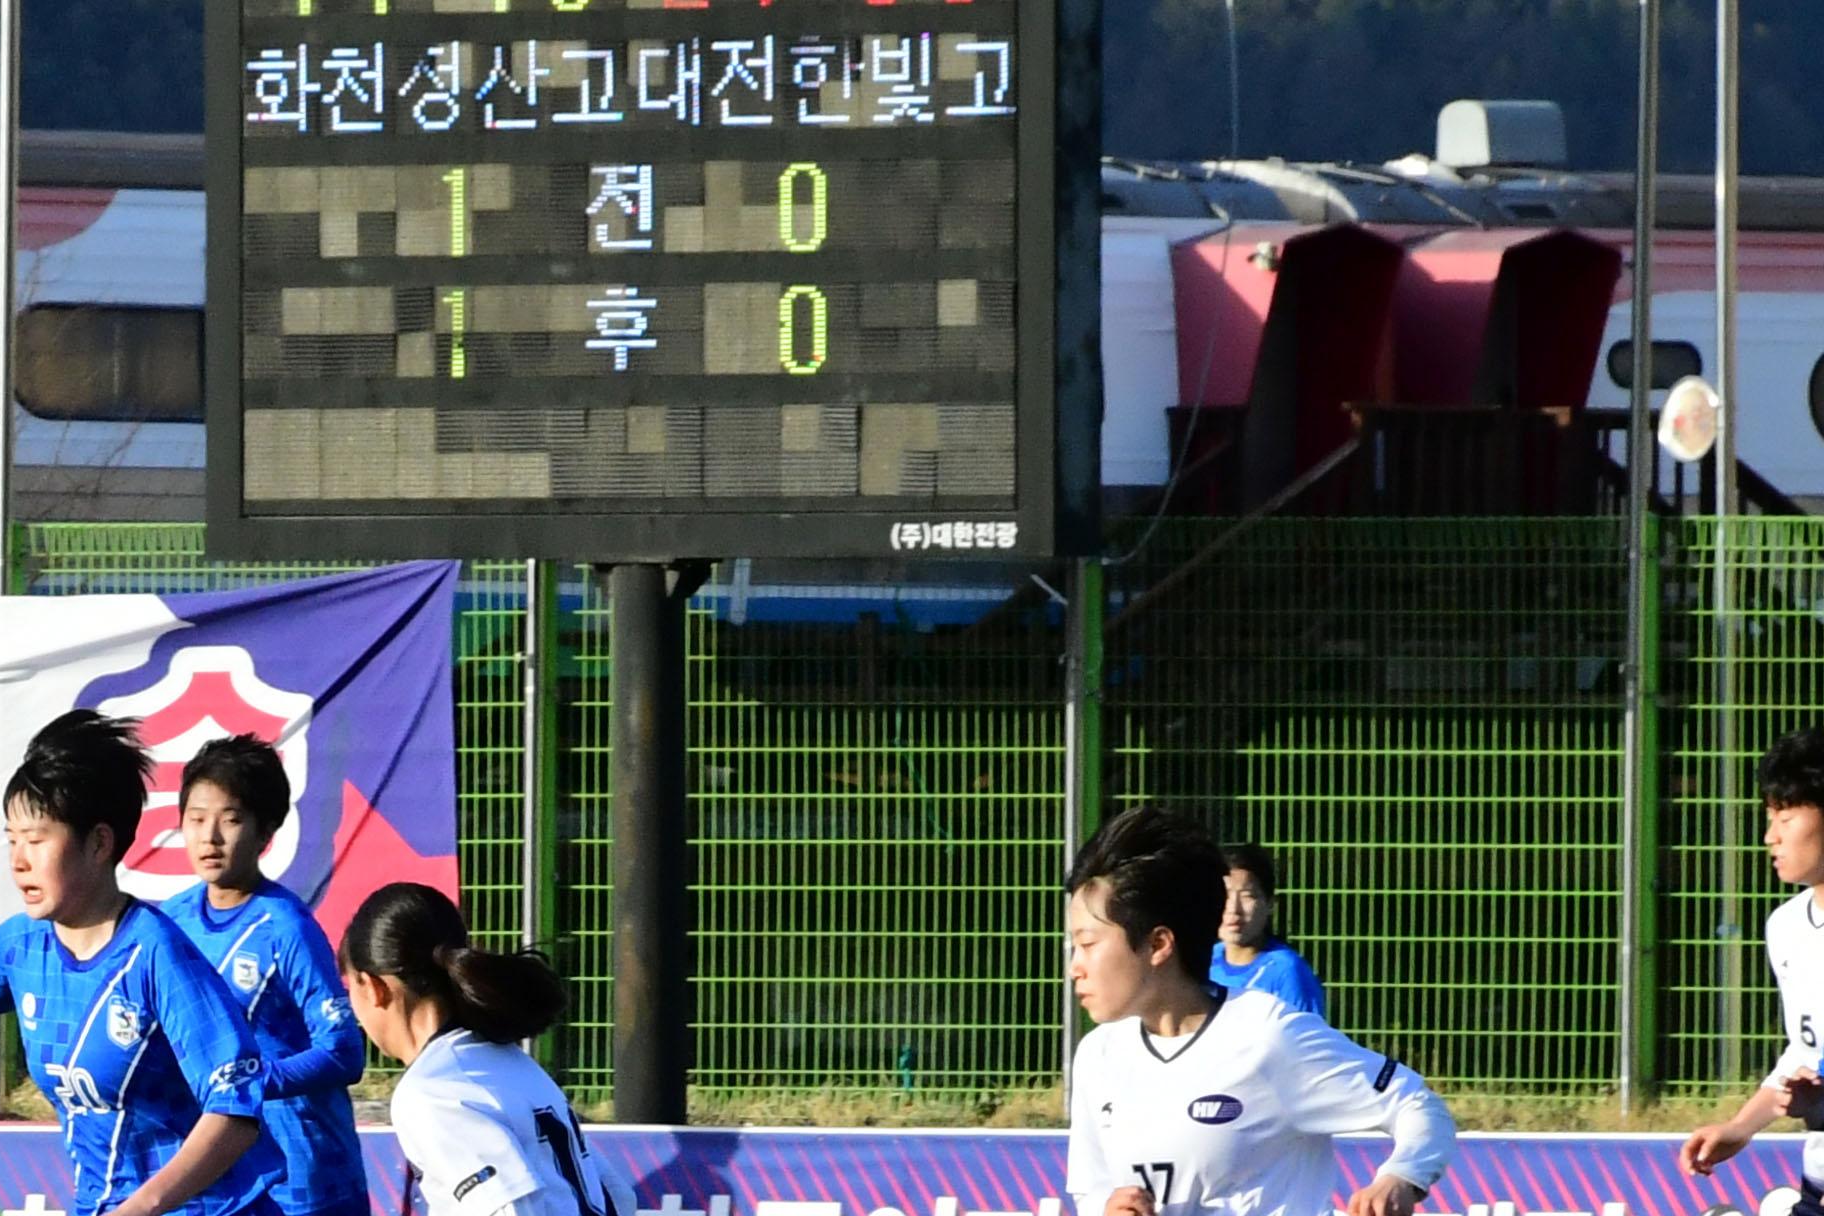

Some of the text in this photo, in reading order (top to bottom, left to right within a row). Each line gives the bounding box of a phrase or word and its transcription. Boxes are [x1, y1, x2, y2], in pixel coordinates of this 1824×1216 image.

[442, 162, 827, 257] 1 전 0
[442, 285, 827, 378] 1 후 0
[1800, 1014, 1818, 1048] 5
[45, 1063, 111, 1117] 20
[1132, 1162, 1174, 1205] 17
